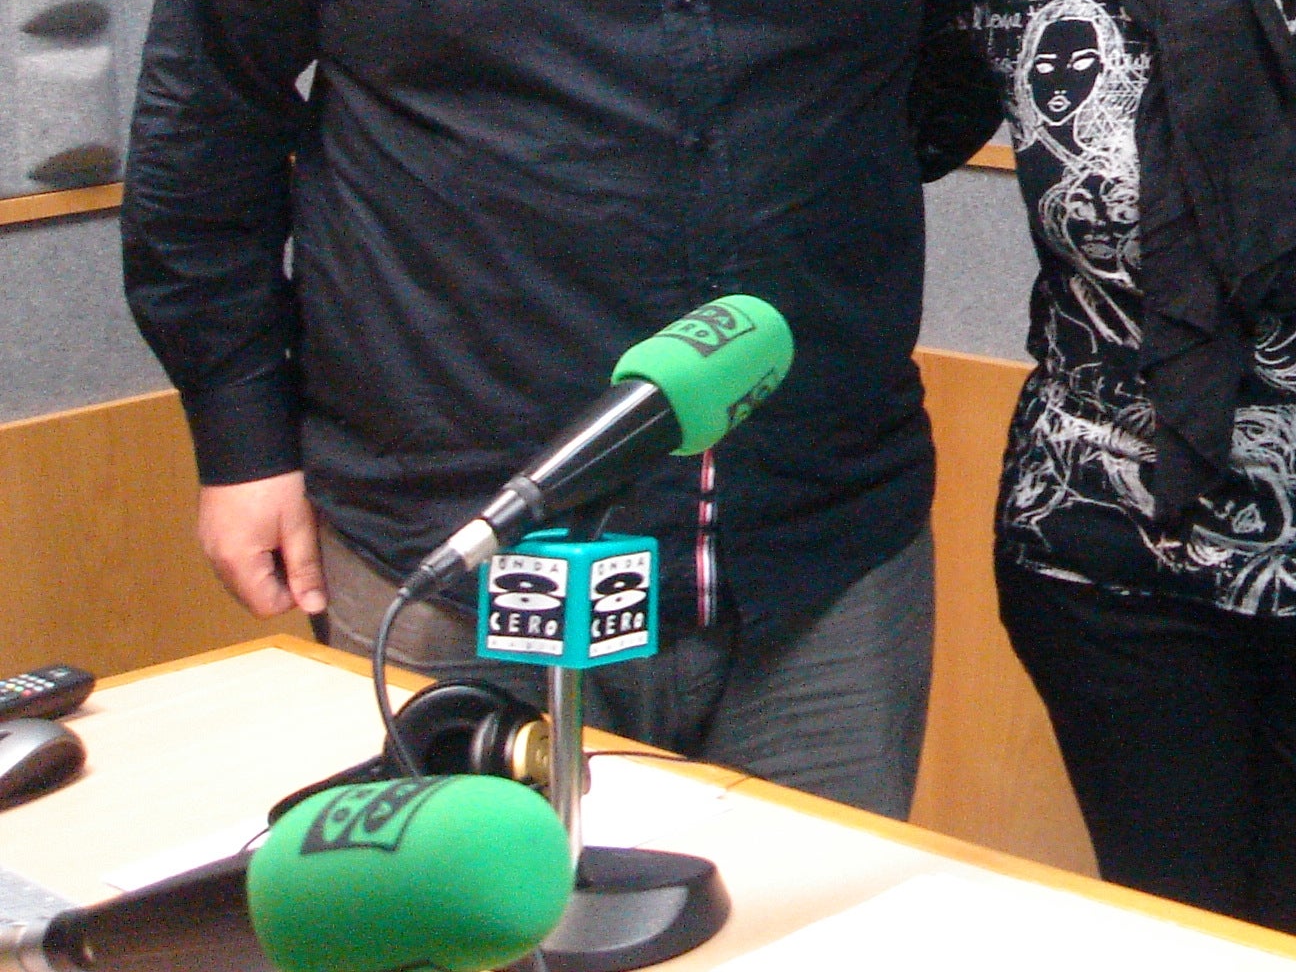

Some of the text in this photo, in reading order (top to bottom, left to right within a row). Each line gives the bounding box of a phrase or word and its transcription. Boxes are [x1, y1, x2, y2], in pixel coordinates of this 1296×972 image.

[498, 557, 560, 573] ONDA
[597, 556, 645, 576] ONDA
[489, 611, 559, 636] CERO
[590, 611, 645, 638] CERO
